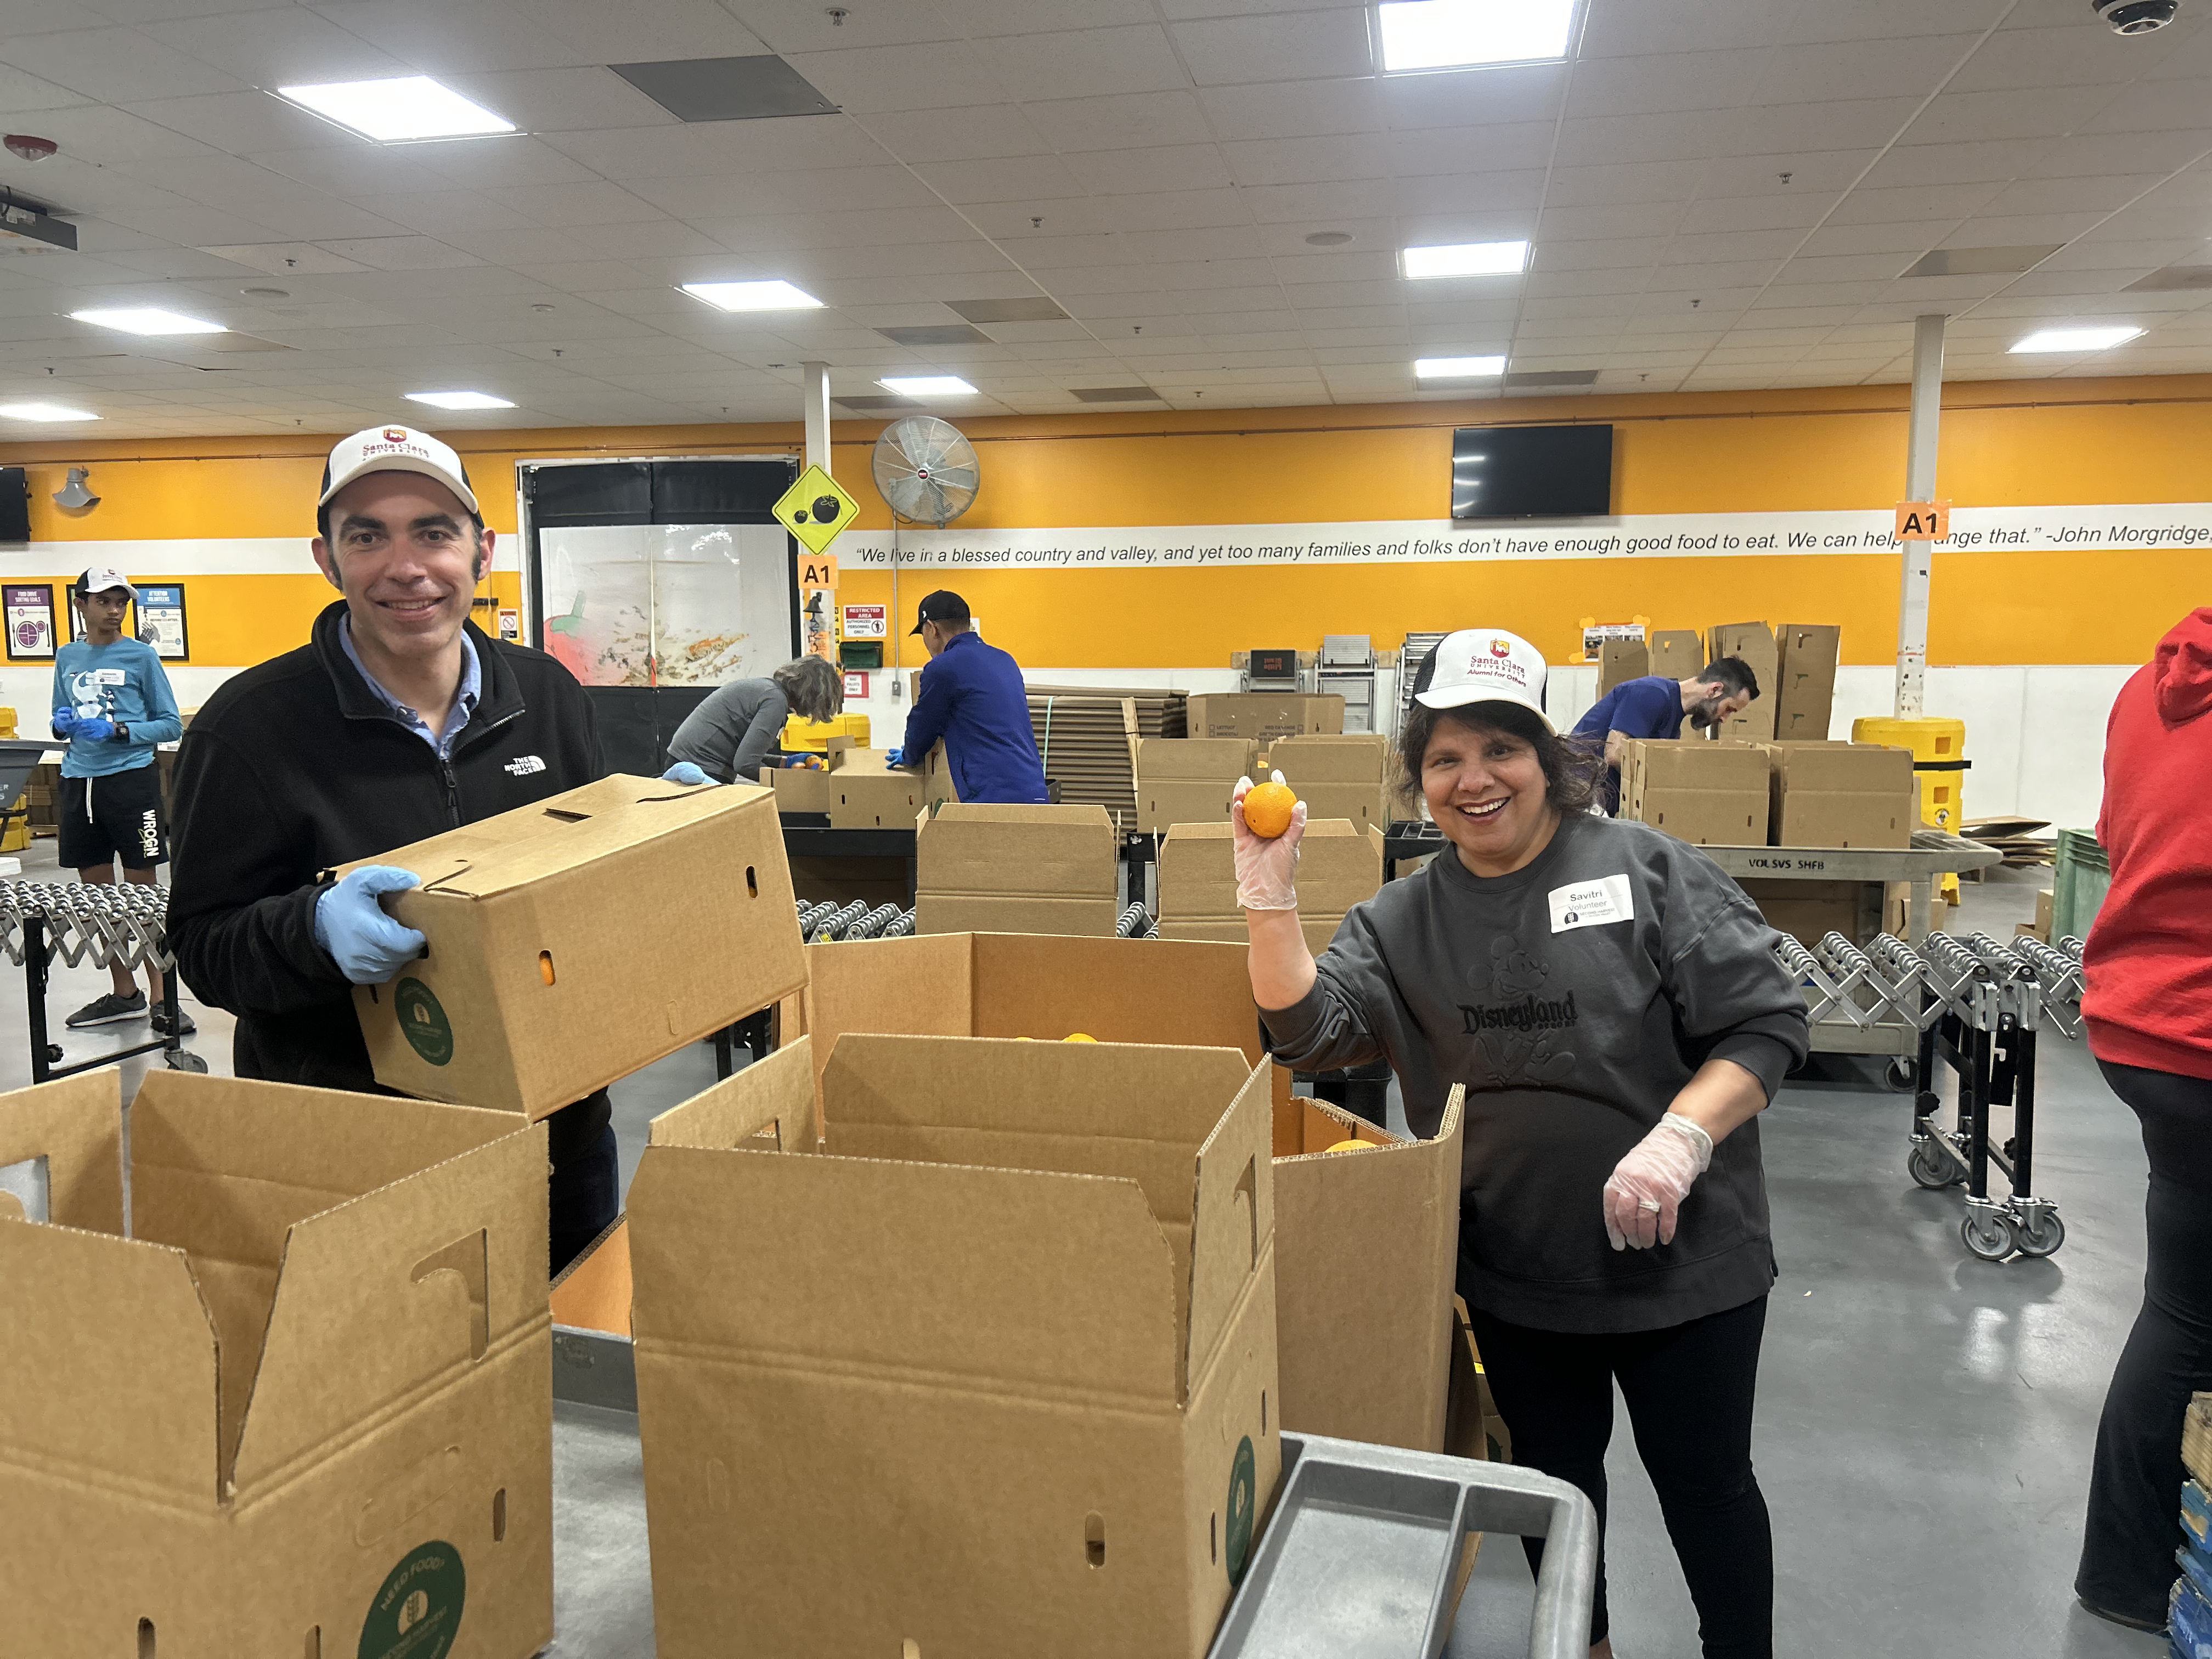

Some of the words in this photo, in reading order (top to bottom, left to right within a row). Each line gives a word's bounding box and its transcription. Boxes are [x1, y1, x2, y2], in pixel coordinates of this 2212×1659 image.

[362, 449, 430, 458] UNIVERSITY
[363, 443, 396, 453] Santa
[398, 443, 429, 455] Clara
[1901, 512, 1937, 534] A1
[856, 548, 885, 562] “We
[890, 548, 915, 562] live
[920, 548, 933, 562] in
[938, 551, 947, 562] a
[952, 548, 1011, 562] blessed
[1015, 548, 1072, 565] country
[1076, 546, 1106, 561] and
[1111, 546, 1157, 563] valley,
[1164, 545, 1194, 560] and
[1198, 545, 1223, 563] yet
[1228, 545, 1252, 558] too
[1258, 546, 1304, 561] many
[1308, 541, 1371, 556] families
[1376, 540, 1409, 555] and
[1414, 540, 1453, 554] folks
[1459, 538, 1501, 554] don’t
[1506, 538, 1548, 552] have
[1555, 535, 1621, 554] enough
[1626, 534, 1673, 554] good
[1678, 534, 1718, 549] food
[1723, 534, 1740, 549] to
[1746, 534, 1778, 548] eat.
[1788, 532, 1816, 548] We
[1824, 535, 1857, 547] can
[1989, 527, 2041, 544] that.”
[2046, 527, 2101, 543] -John
[804, 565, 829, 583] A1
[1470, 655, 1499, 665] Santa
[1502, 659, 1525, 674] Clara
[1470, 663, 1525, 679] UNIVERSITY
[1506, 674, 1526, 687] Others
[504, 761, 531, 771] NORTH
[513, 767, 533, 776] FACE
[143, 809, 160, 857] WROGN
[1748, 859, 1769, 868] VOL
[1772, 859, 1791, 868] SVS
[1798, 860, 1824, 870] SHFB
[1570, 889, 1602, 901] Savitri
[1568, 900, 1607, 912] Volunteer
[1456, 990, 1579, 1035] Disneyland
[380, 1572, 409, 1611] NEED
